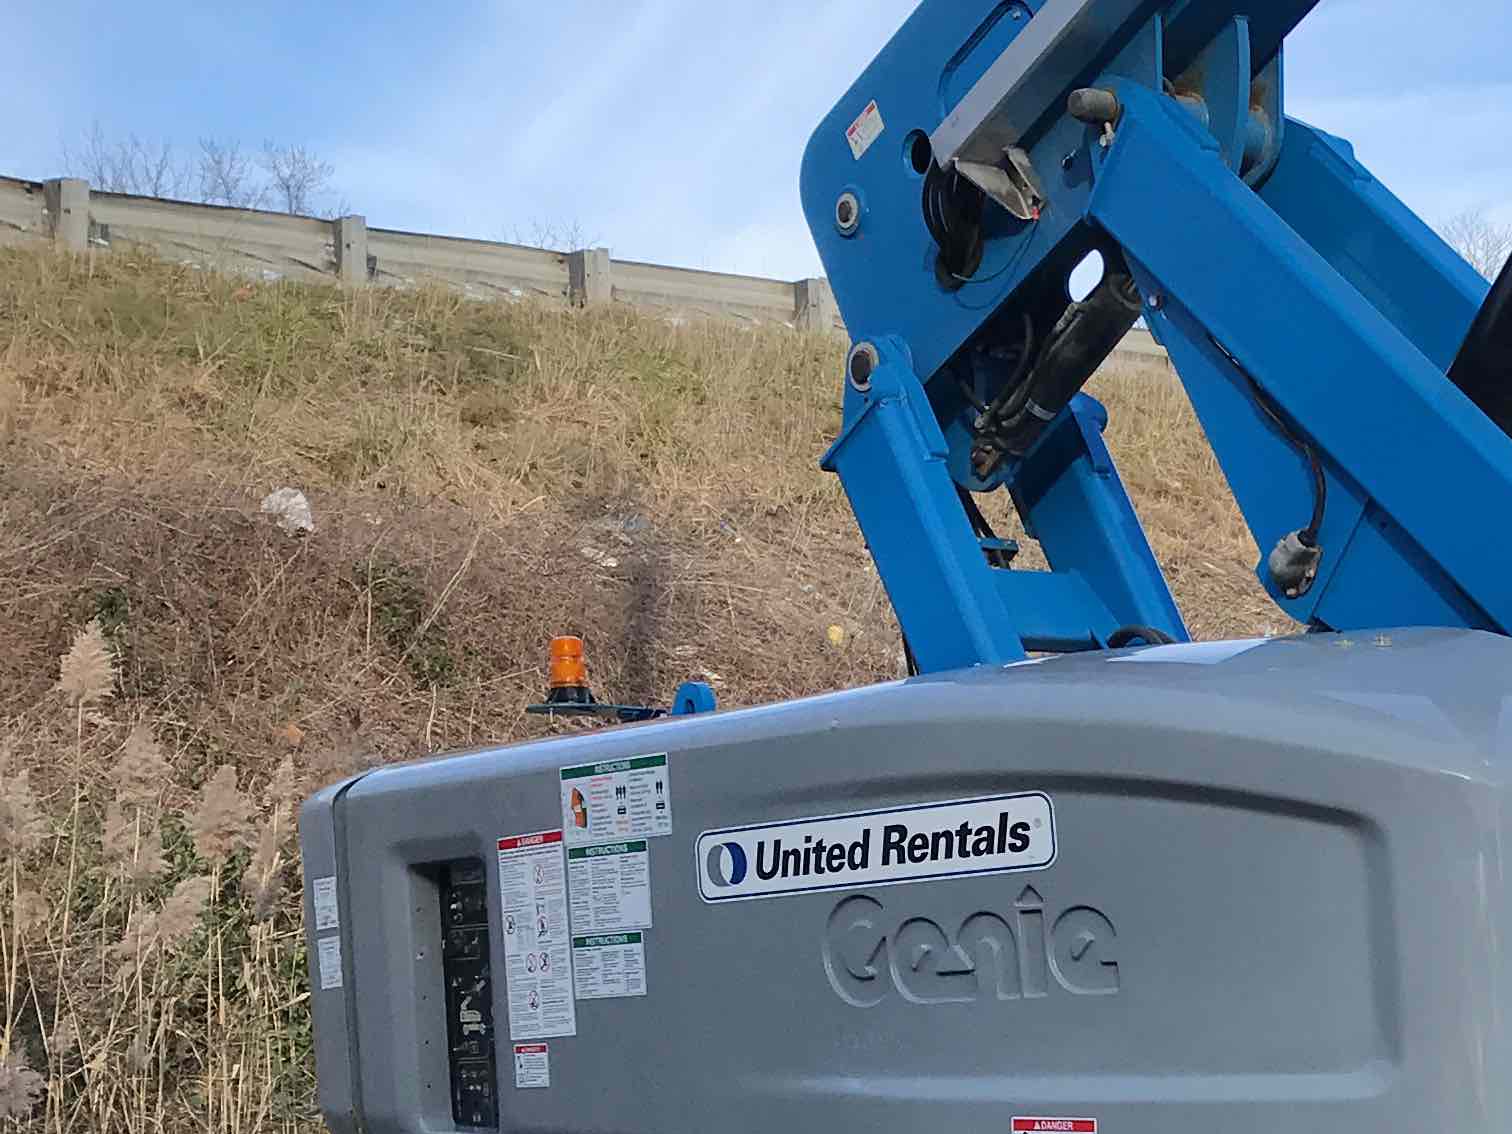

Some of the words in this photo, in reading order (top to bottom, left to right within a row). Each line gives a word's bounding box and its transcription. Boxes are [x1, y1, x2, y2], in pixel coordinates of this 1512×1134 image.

[755, 828, 871, 881] United
[880, 811, 1032, 867] Rentals
[821, 884, 1121, 1008] Genie
[1040, 1120, 1073, 1131] DANGER
